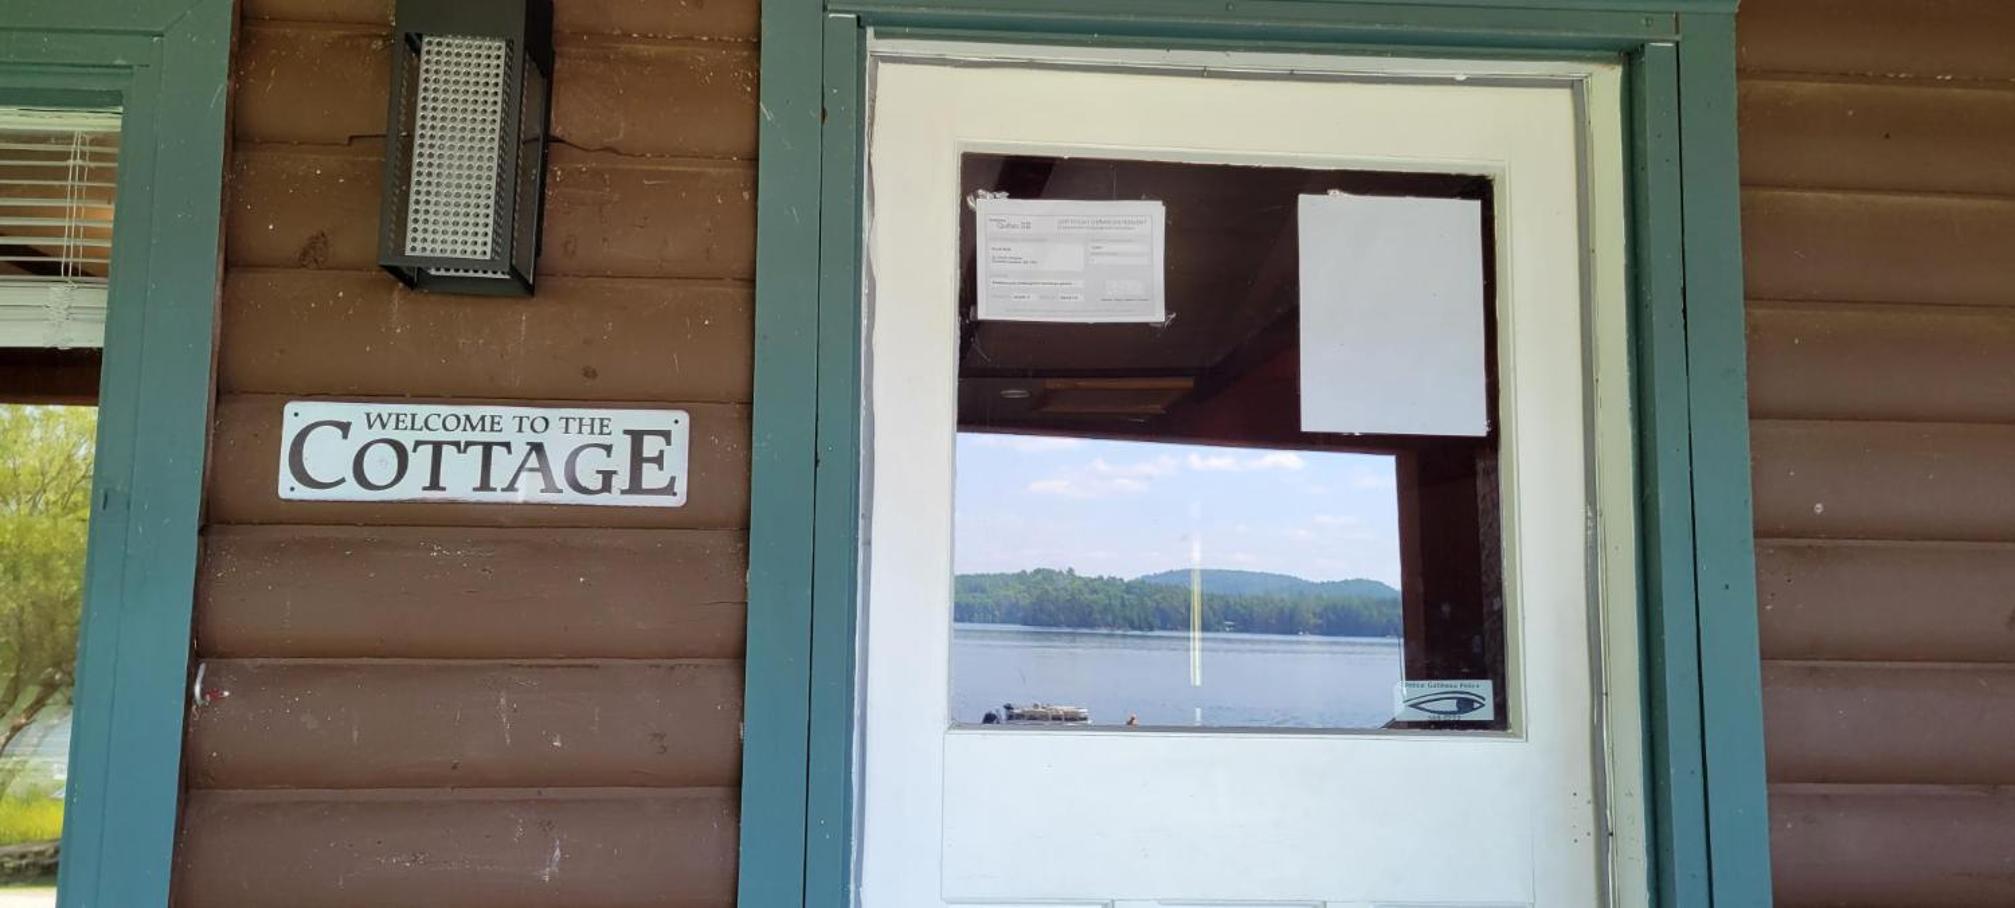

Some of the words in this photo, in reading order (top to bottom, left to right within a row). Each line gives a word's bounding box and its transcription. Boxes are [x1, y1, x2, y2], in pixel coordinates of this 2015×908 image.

[365, 411, 503, 433] WELCOME
[513, 415, 550, 434] TO
[558, 416, 612, 436] THE
[288, 420, 678, 497] COTTAGE
